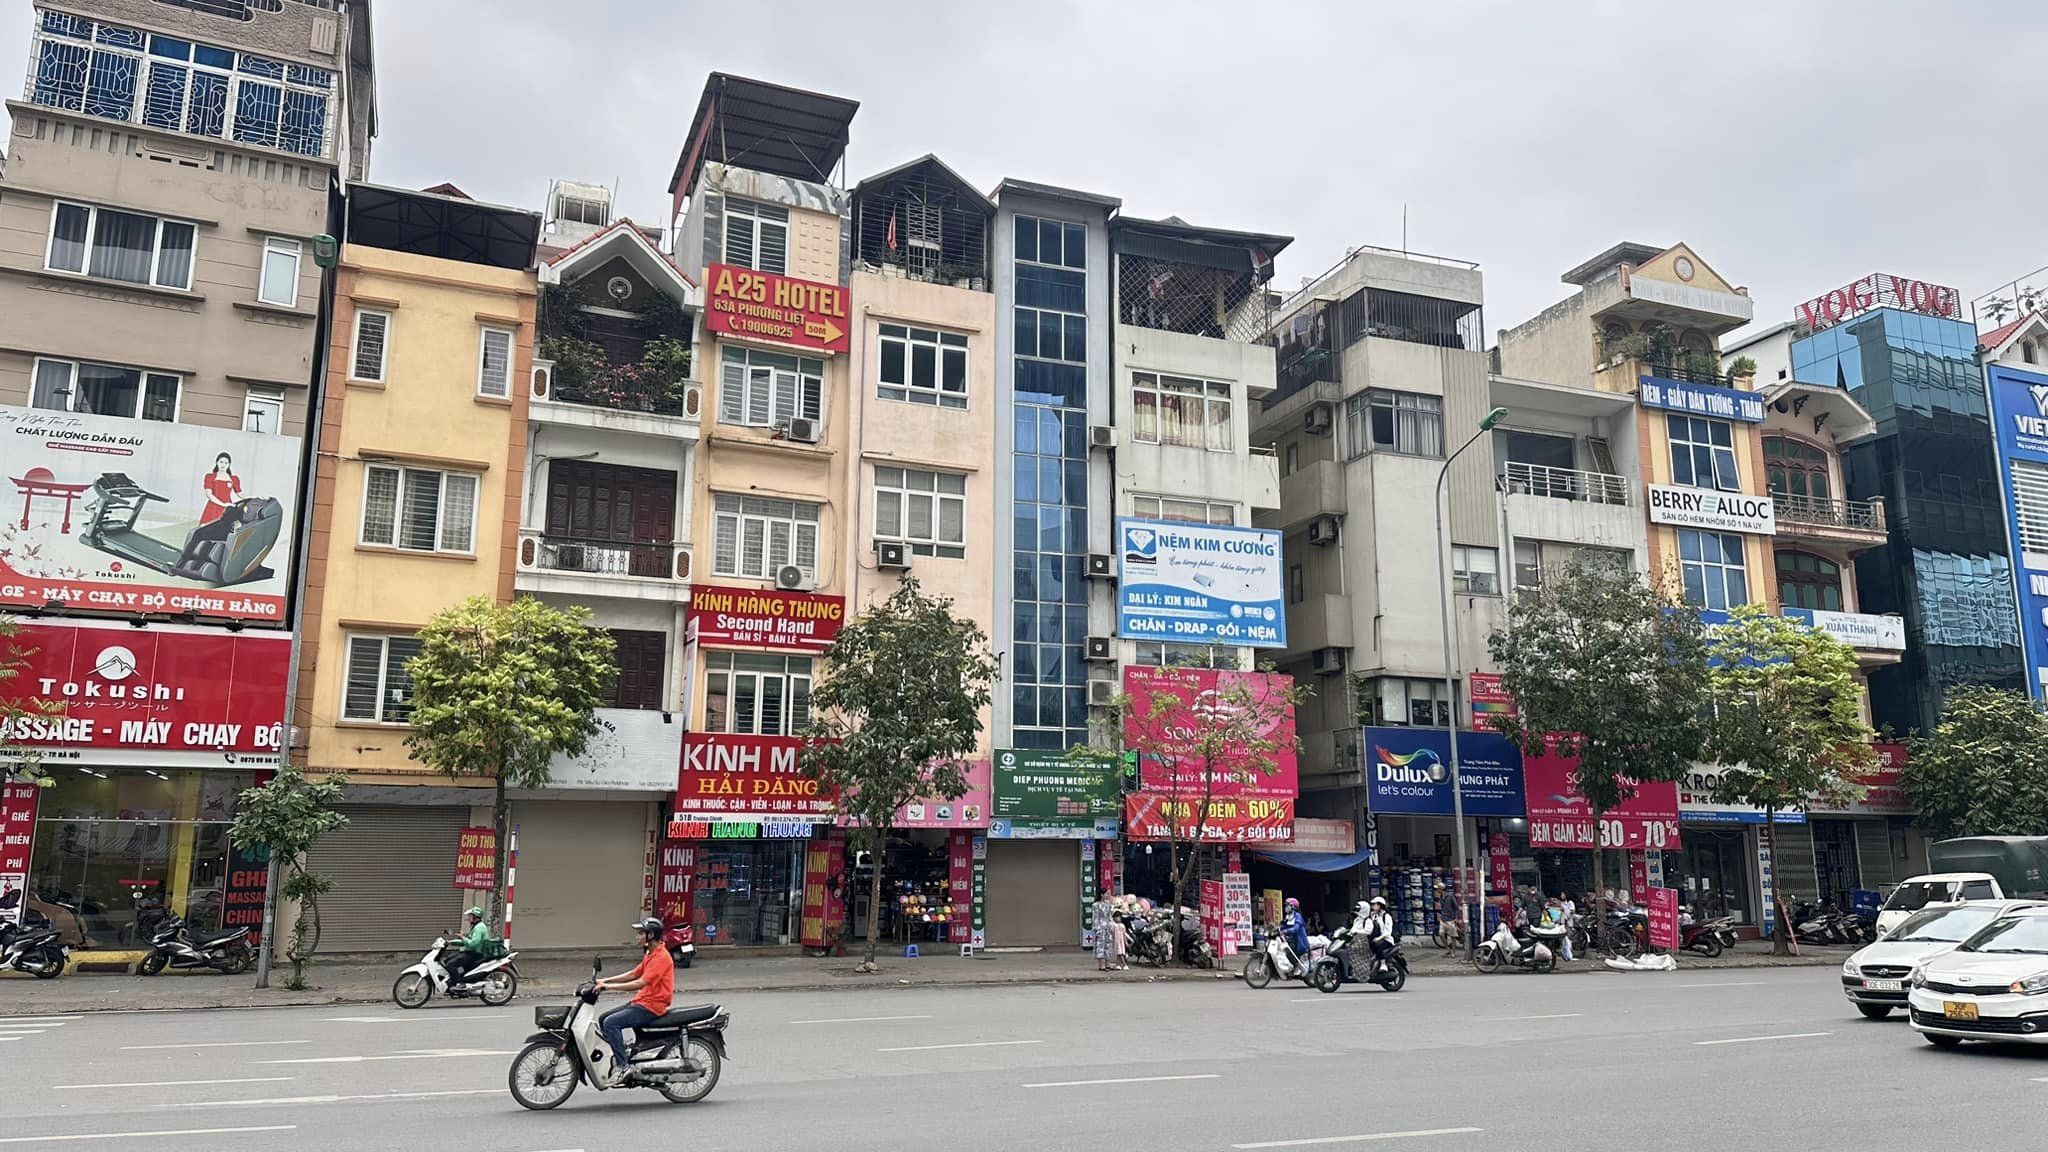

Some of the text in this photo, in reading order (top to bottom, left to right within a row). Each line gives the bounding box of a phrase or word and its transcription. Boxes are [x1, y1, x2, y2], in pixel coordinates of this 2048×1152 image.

[713, 268, 845, 318] A25 HOTEL
[1801, 276, 1873, 329] VOG
[1890, 275, 1955, 317] VOG
[714, 298, 736, 313] 63A
[784, 310, 806, 328] LIỆT
[741, 318, 793, 338] 19006925
[1642, 382, 1661, 404] RÈM
[1667, 383, 1687, 409] GIẤY
[1688, 389, 1706, 411] DÁN
[1740, 396, 1763, 419] THẢM
[15, 424, 48, 438] CHẤT
[49, 428, 89, 442] LƯỢNG
[91, 432, 117, 444] DẪN
[1651, 488, 1769, 519] BERRY ALLOC
[1159, 532, 1275, 557] NỆM KIM CƯƠNG
[42, 586, 277, 614] MÁY CHẠY BỘ CHÍNH HÃNG
[693, 588, 842, 620] KÍNH HÀNG THÙNG
[1164, 594, 1181, 606] KIM
[717, 613, 814, 635] Second Hand
[1129, 617, 1166, 632] CHĂN
[1174, 620, 1209, 635] DRAP
[1248, 625, 1277, 641] NỆM
[1849, 623, 1878, 635] THANH
[733, 630, 751, 642] BÁN
[768, 632, 786, 644] BÁN
[39, 677, 184, 701] Tokushi
[120, 716, 284, 752] MÁY CHẠY BỘ
[683, 737, 761, 772] KÍNH
[697, 773, 818, 795] HẢI ĐĂNG
[1376, 763, 1433, 783] Dulux
[1485, 773, 1510, 786] PHÁT
[1378, 784, 1434, 797] let's colour
[1693, 795, 1708, 805] THE
[11, 809, 31, 822] GHẾ
[729, 799, 746, 811] CẬN
[1208, 802, 1236, 822] ĐỆM
[1248, 799, 1285, 819] 60%
[461, 834, 497, 849] CHO THU
[1553, 818, 1575, 843] GIẢM
[1600, 819, 1624, 847] 30
[1642, 820, 1678, 847] 70%
[6, 857, 23, 869] PHÍ
[457, 850, 474, 868] CỬA
[664, 844, 695, 867] KÍNH
[664, 867, 692, 893] MẮT
[1226, 890, 1249, 901] 30%
[226, 906, 264, 924] CHÍN
